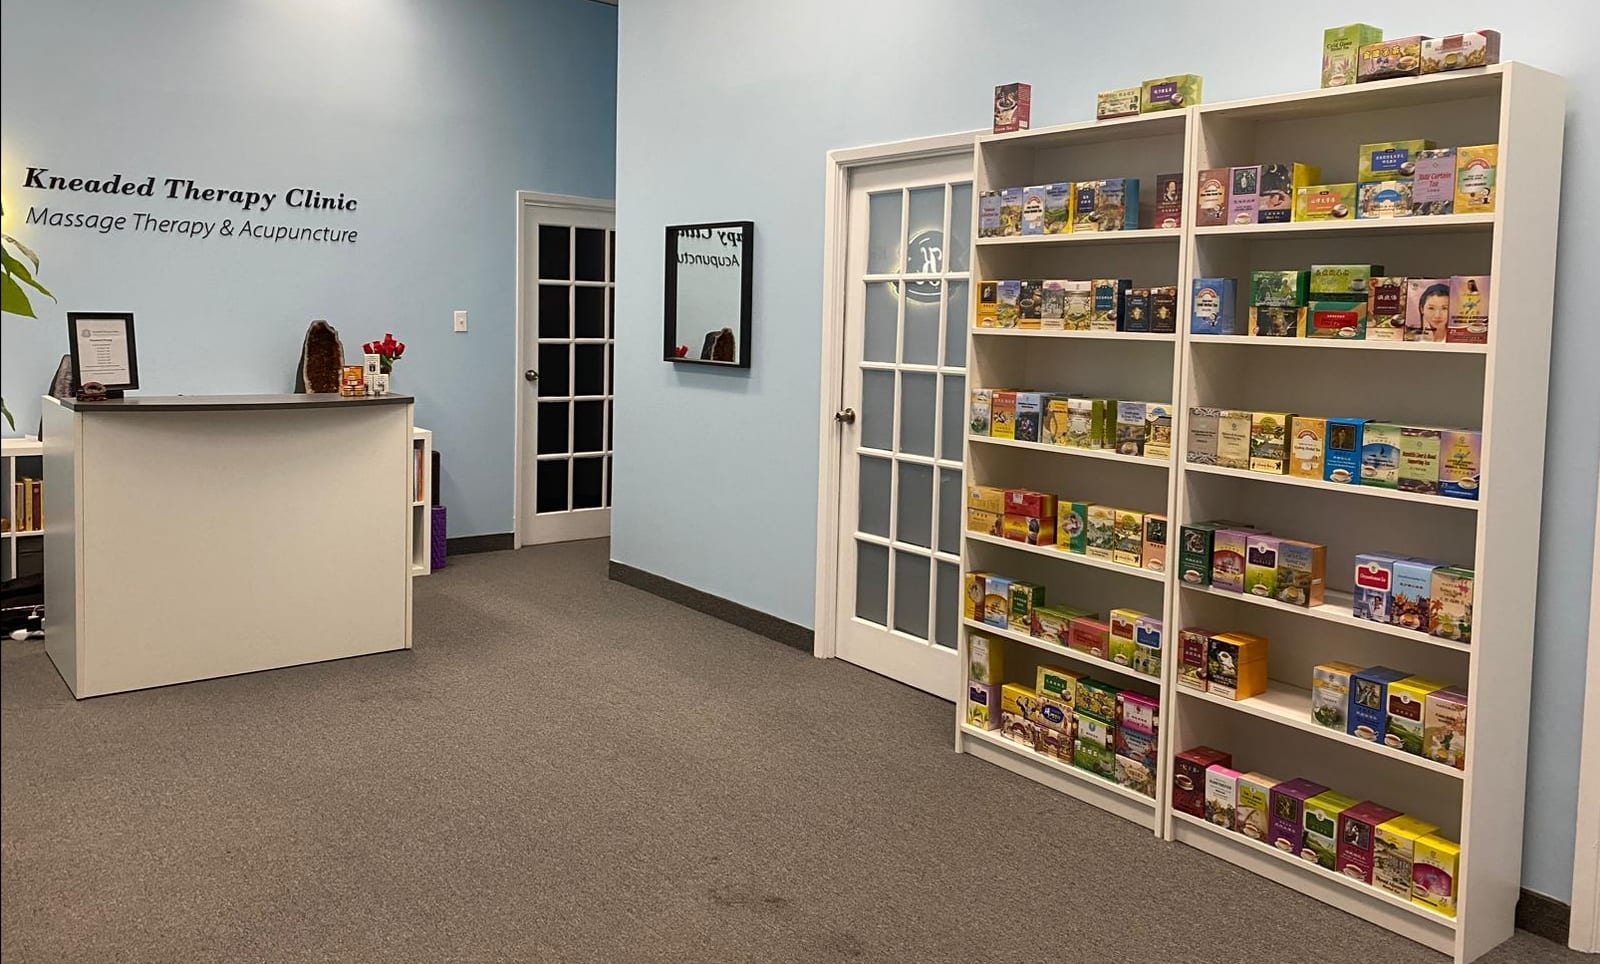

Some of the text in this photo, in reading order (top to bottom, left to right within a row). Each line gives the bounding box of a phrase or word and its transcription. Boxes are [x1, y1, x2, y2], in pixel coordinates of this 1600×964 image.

[23, 167, 358, 212] Kneaded Therapy Clinic
[25, 207, 358, 243] Massage Therapy & Acupuncture
